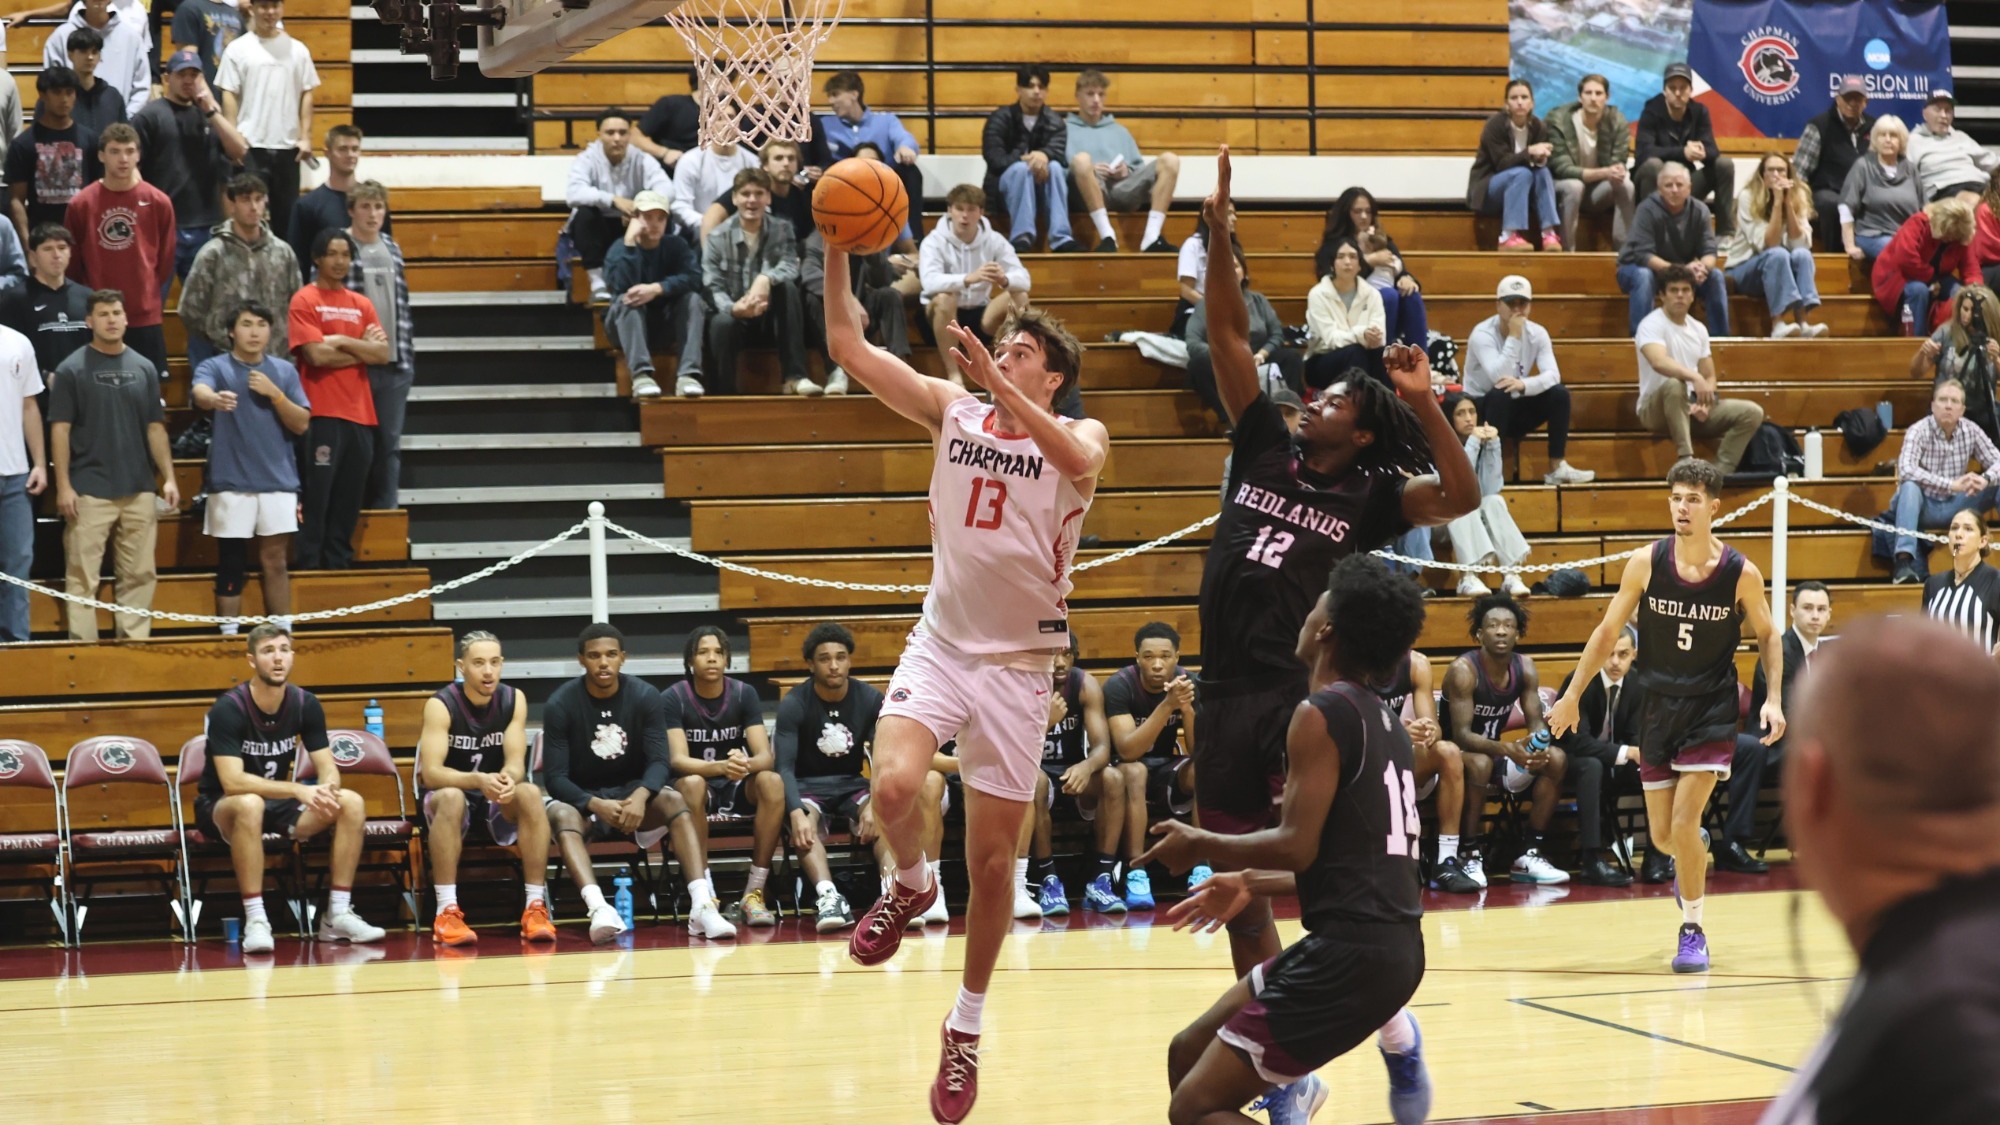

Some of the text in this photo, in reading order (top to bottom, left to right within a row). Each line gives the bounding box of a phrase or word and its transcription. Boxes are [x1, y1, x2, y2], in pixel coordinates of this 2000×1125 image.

[1741, 25, 1799, 48] CHAPMAN
[1829, 72, 1929, 92] DSION III
[1742, 82, 1801, 106] UNIVERSITY
[949, 438, 1043, 480] CHAPMAN
[964, 476, 1007, 531] 13
[1234, 482, 1350, 543] REDLANDS
[1246, 525, 1295, 569] 12
[1648, 596, 1731, 621] REDLANDS
[1677, 622, 1694, 651] 5
[686, 726, 742, 743] EDLAND
[1483, 719, 1499, 739] 11
[1043, 739, 1064, 760] 21
[264, 761, 278, 781] 2
[470, 753, 483, 773] 7
[0, 838, 43, 850] PMAN
[96, 834, 166, 847] CHAPMAN
